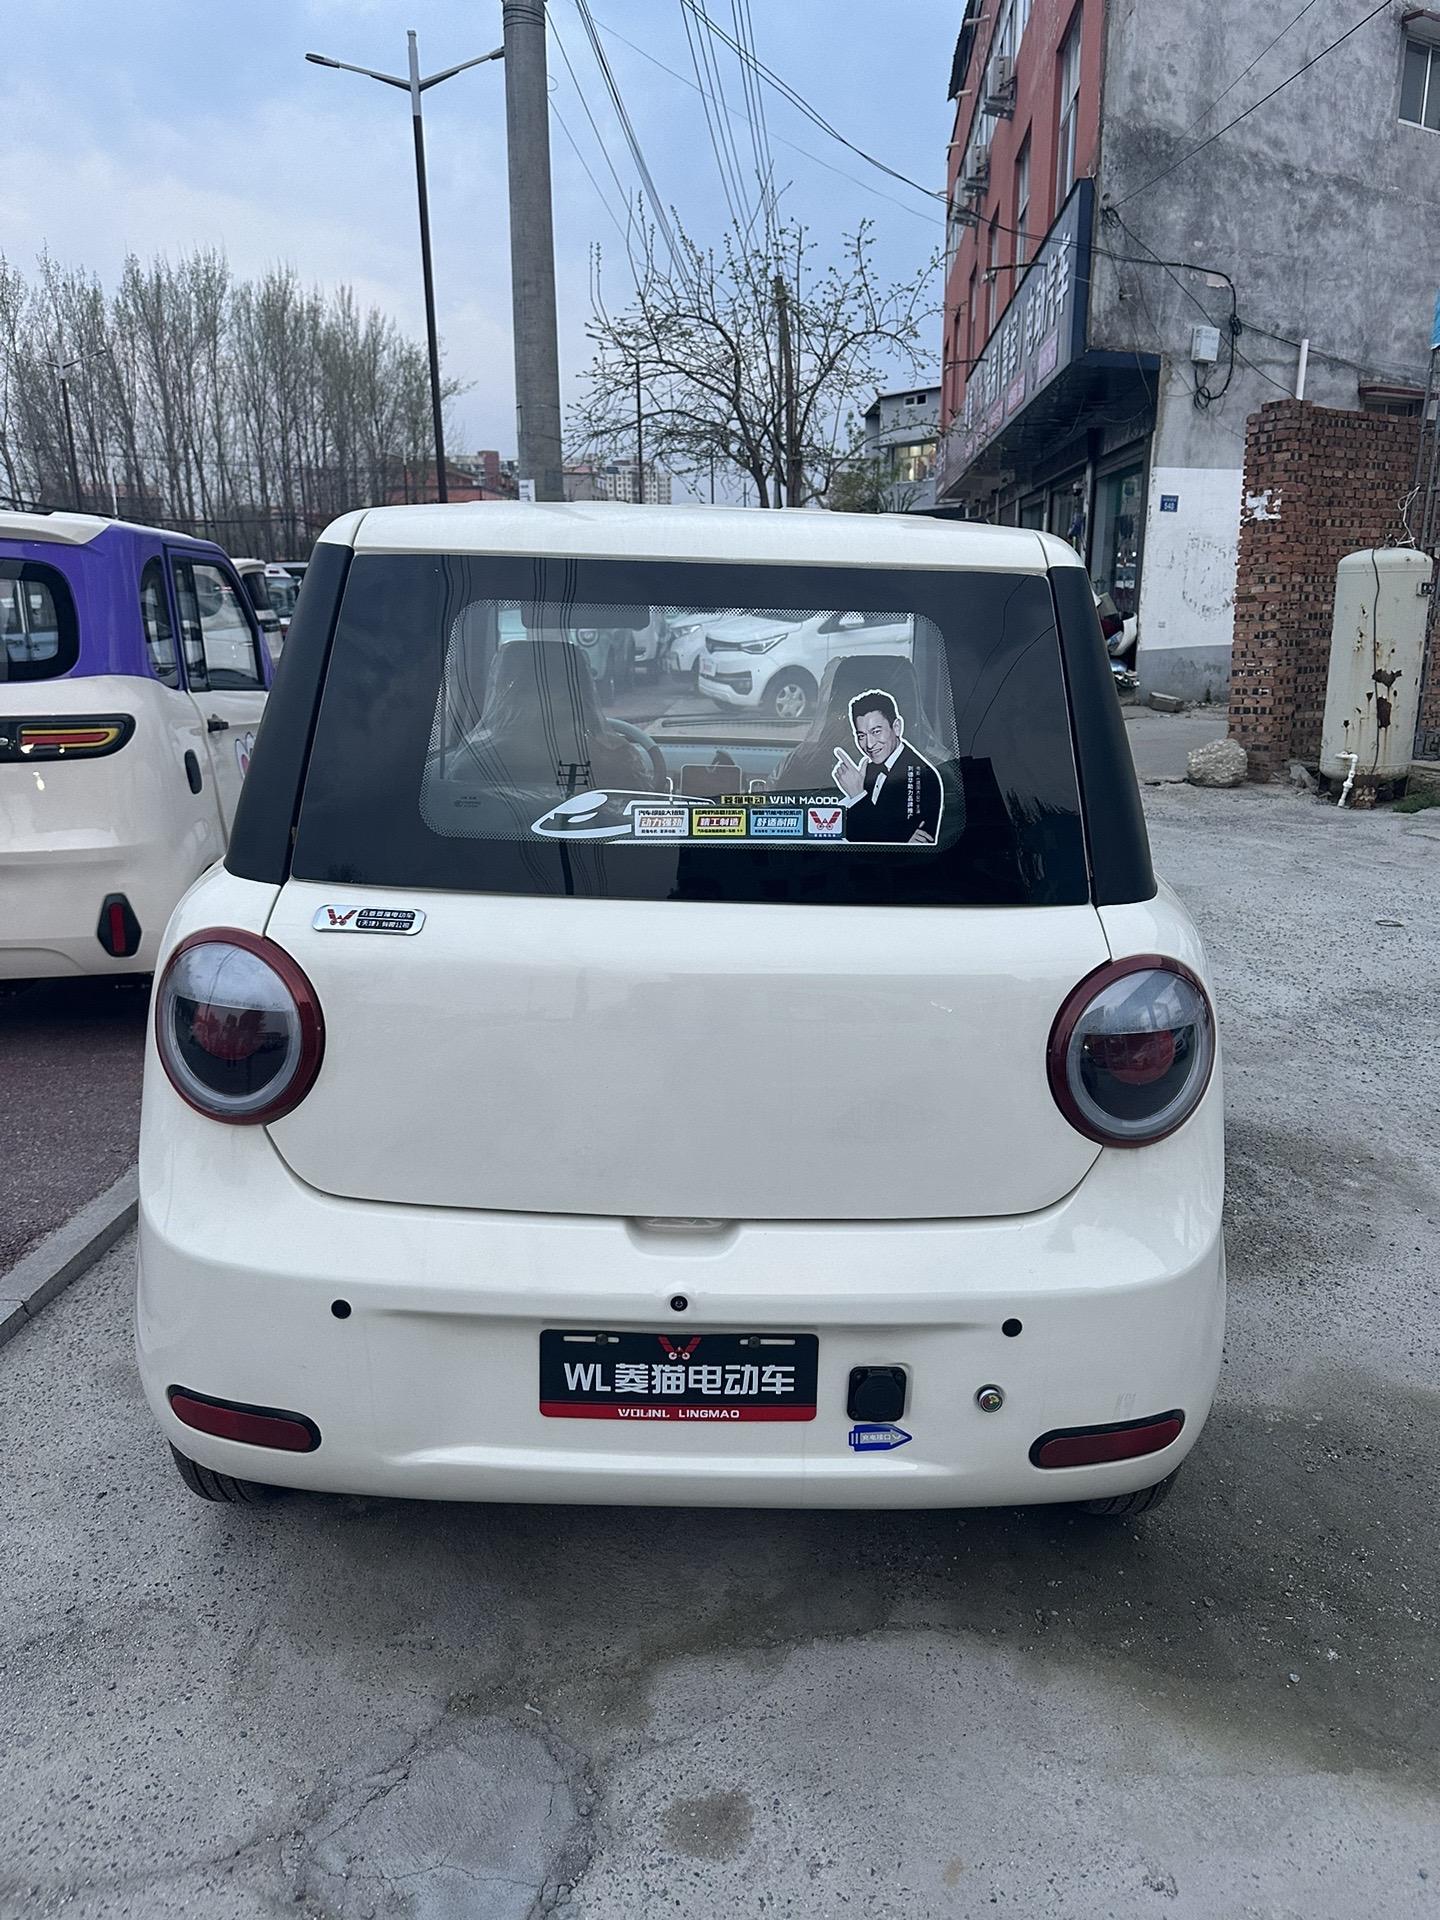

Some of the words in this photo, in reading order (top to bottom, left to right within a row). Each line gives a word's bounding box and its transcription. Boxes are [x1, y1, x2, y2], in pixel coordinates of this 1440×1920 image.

[641, 817, 683, 827] 动力强劲
[700, 817, 739, 827] 精工制造
[756, 817, 797, 827] 舒适耐用
[678, 1409, 740, 1418] LINGMAO
